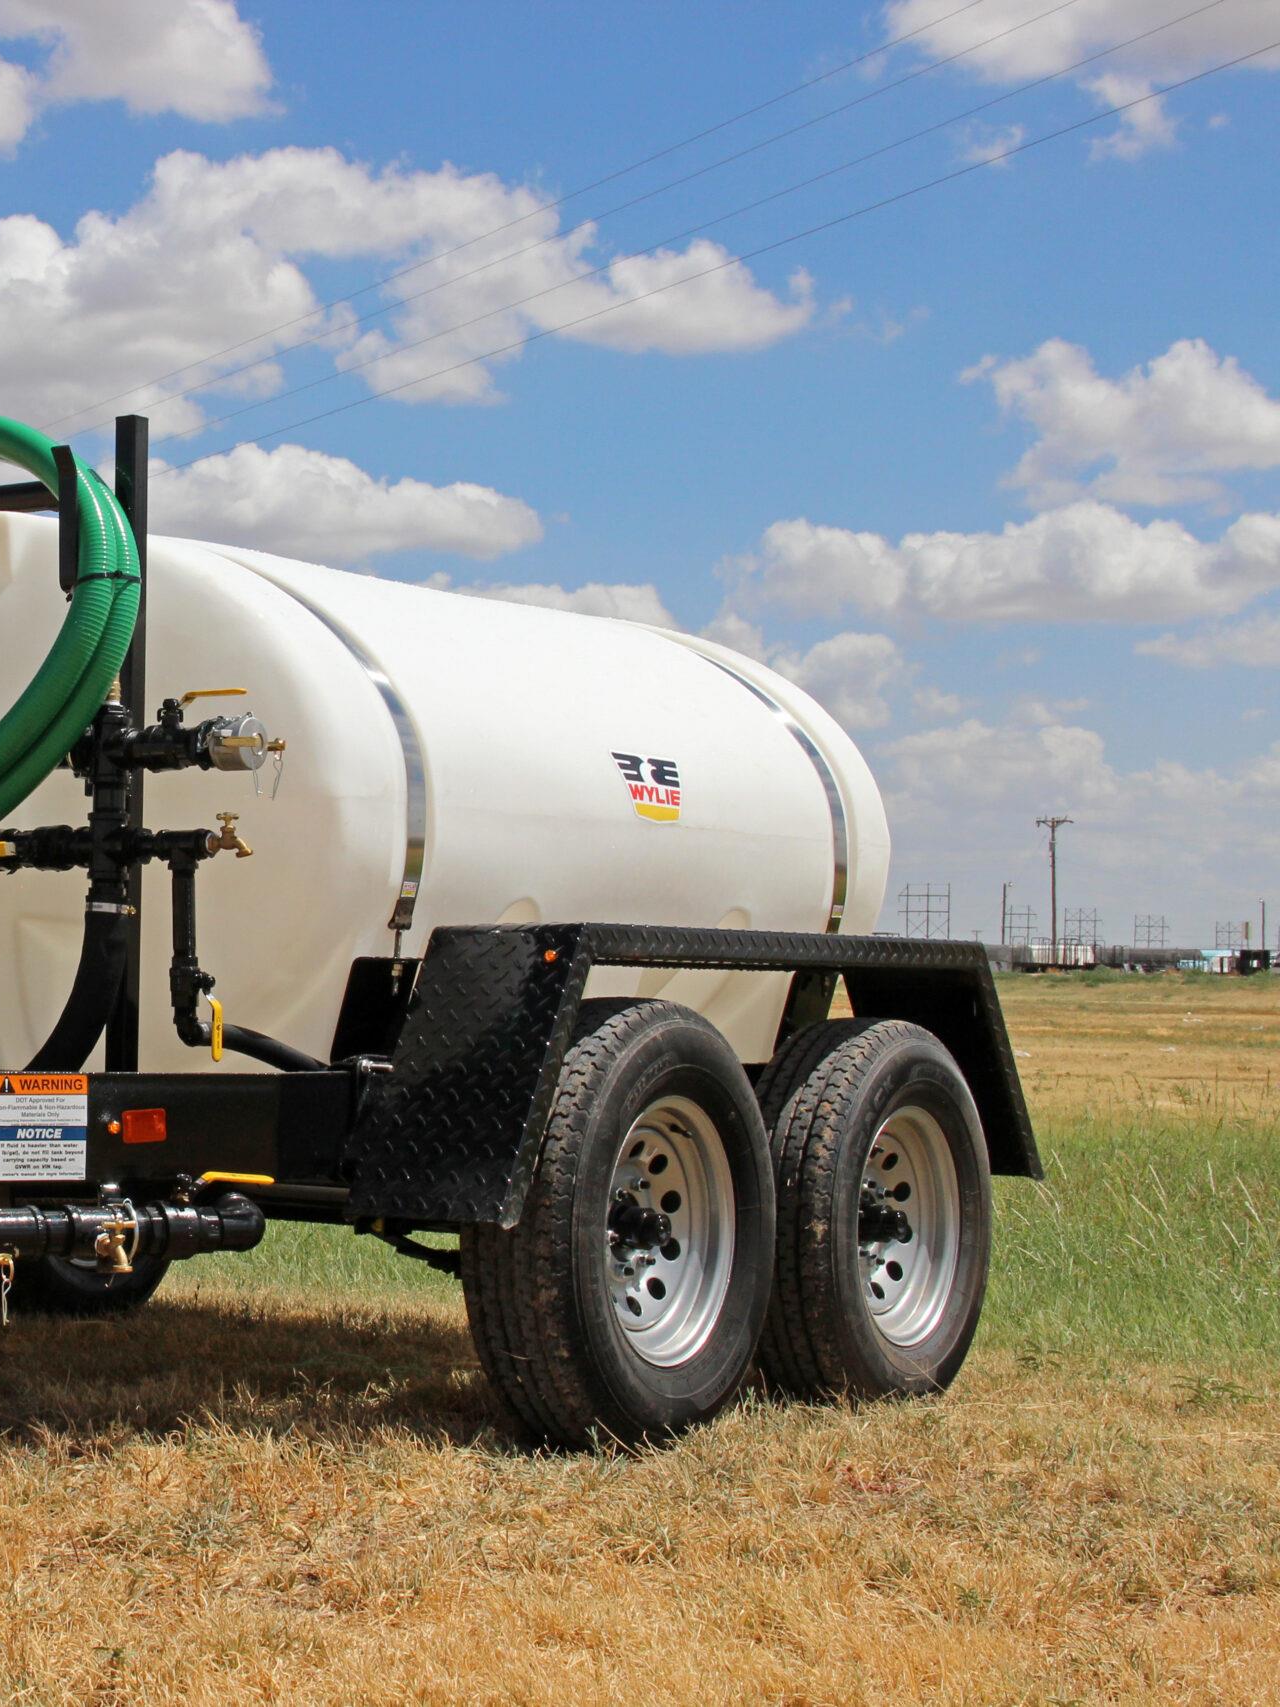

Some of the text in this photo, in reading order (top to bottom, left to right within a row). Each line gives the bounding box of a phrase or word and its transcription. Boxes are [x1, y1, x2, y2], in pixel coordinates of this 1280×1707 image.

[628, 783, 680, 806] WYLIE
[20, 1079, 82, 1090] WARNING
[17, 1129, 62, 1139] NOTICE
